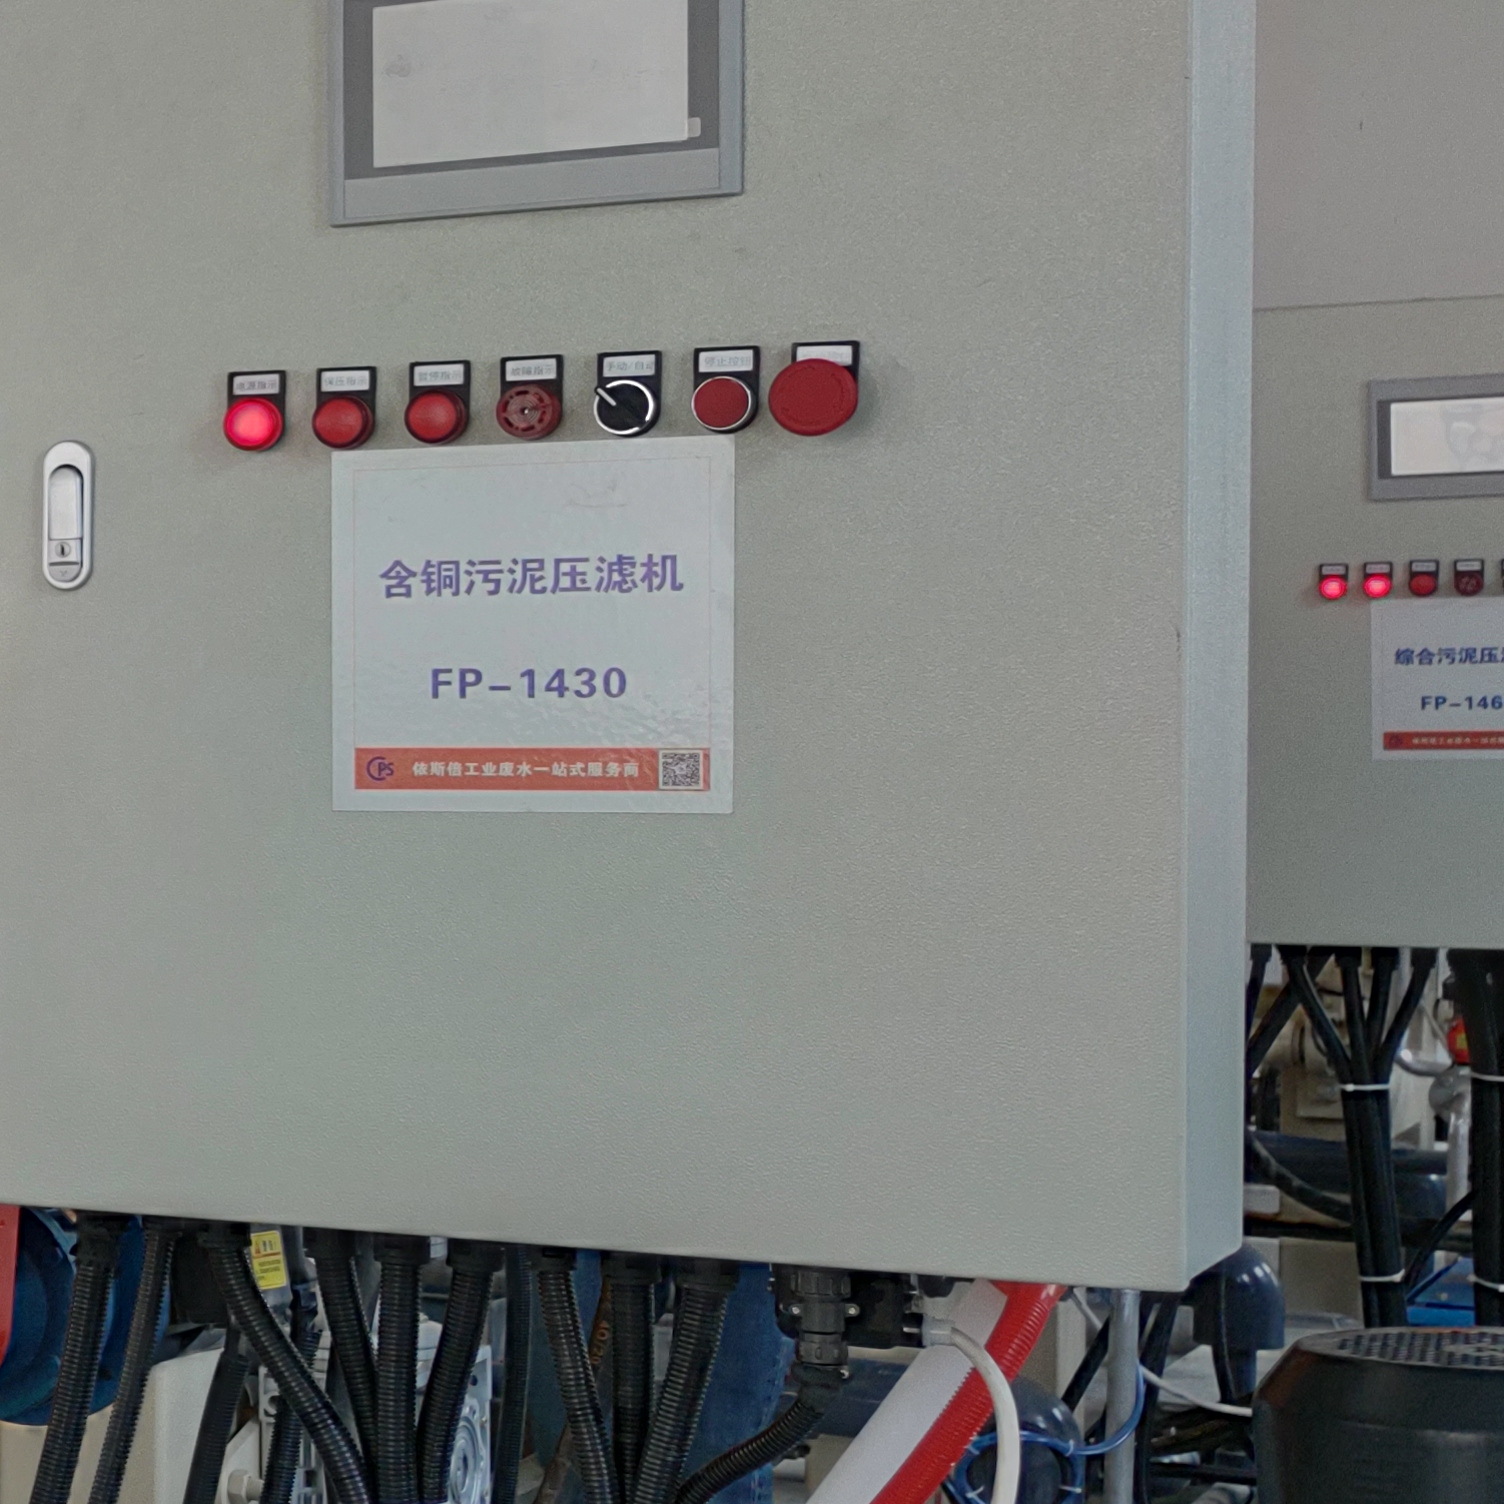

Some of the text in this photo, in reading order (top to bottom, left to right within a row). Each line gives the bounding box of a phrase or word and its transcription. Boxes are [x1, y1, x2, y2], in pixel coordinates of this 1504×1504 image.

[379, 553, 685, 599] 含铜污泥压滤机
[1394, 646, 1504, 667] 综合污泥压
[430, 667, 628, 699] FP-1430
[412, 761, 640, 779] 依斯倍工业废水一站式服务商
